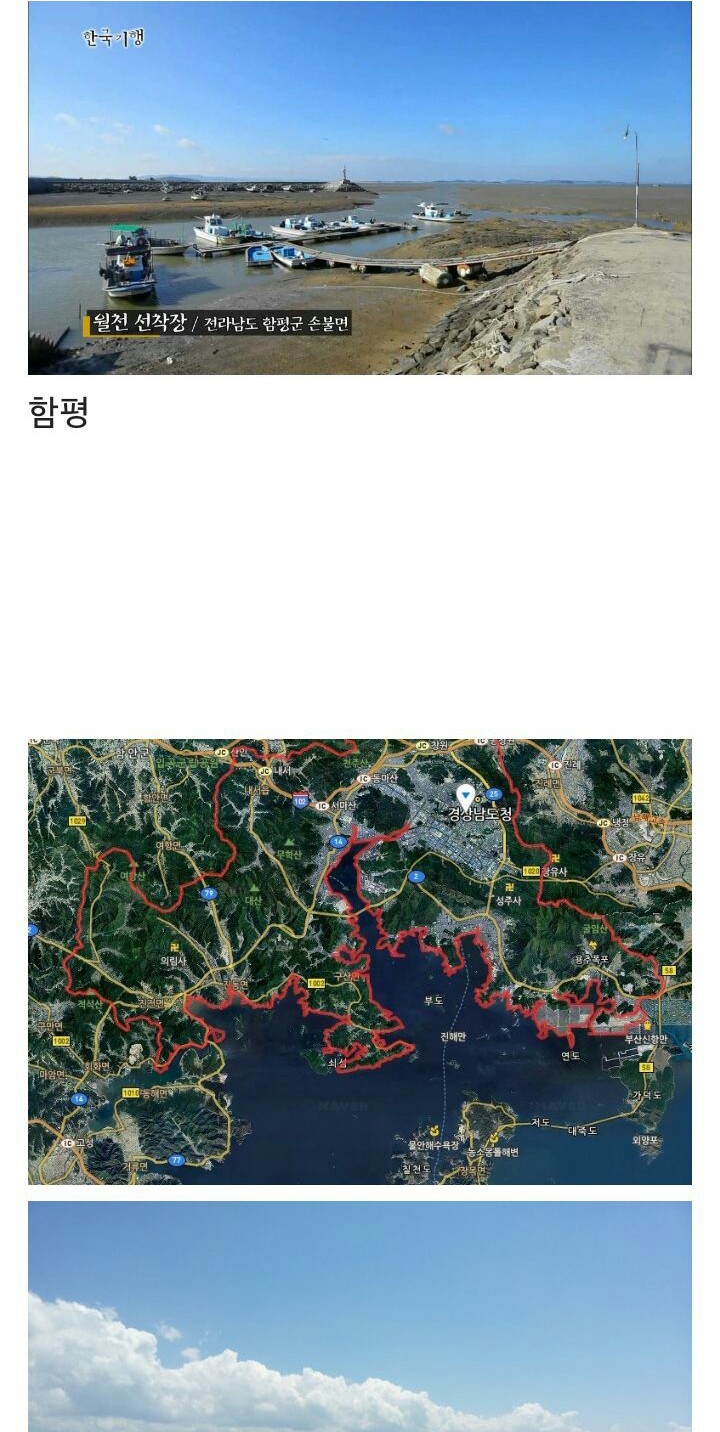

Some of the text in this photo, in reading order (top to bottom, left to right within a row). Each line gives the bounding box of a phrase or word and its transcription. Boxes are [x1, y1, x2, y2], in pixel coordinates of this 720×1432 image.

[431, 741, 448, 750] 창원
[449, 807, 512, 822] 경상남도청
[440, 1032, 466, 1042] 진해만
[625, 1034, 668, 1044] 부산신항만
[531, 1118, 551, 1128] 저도
